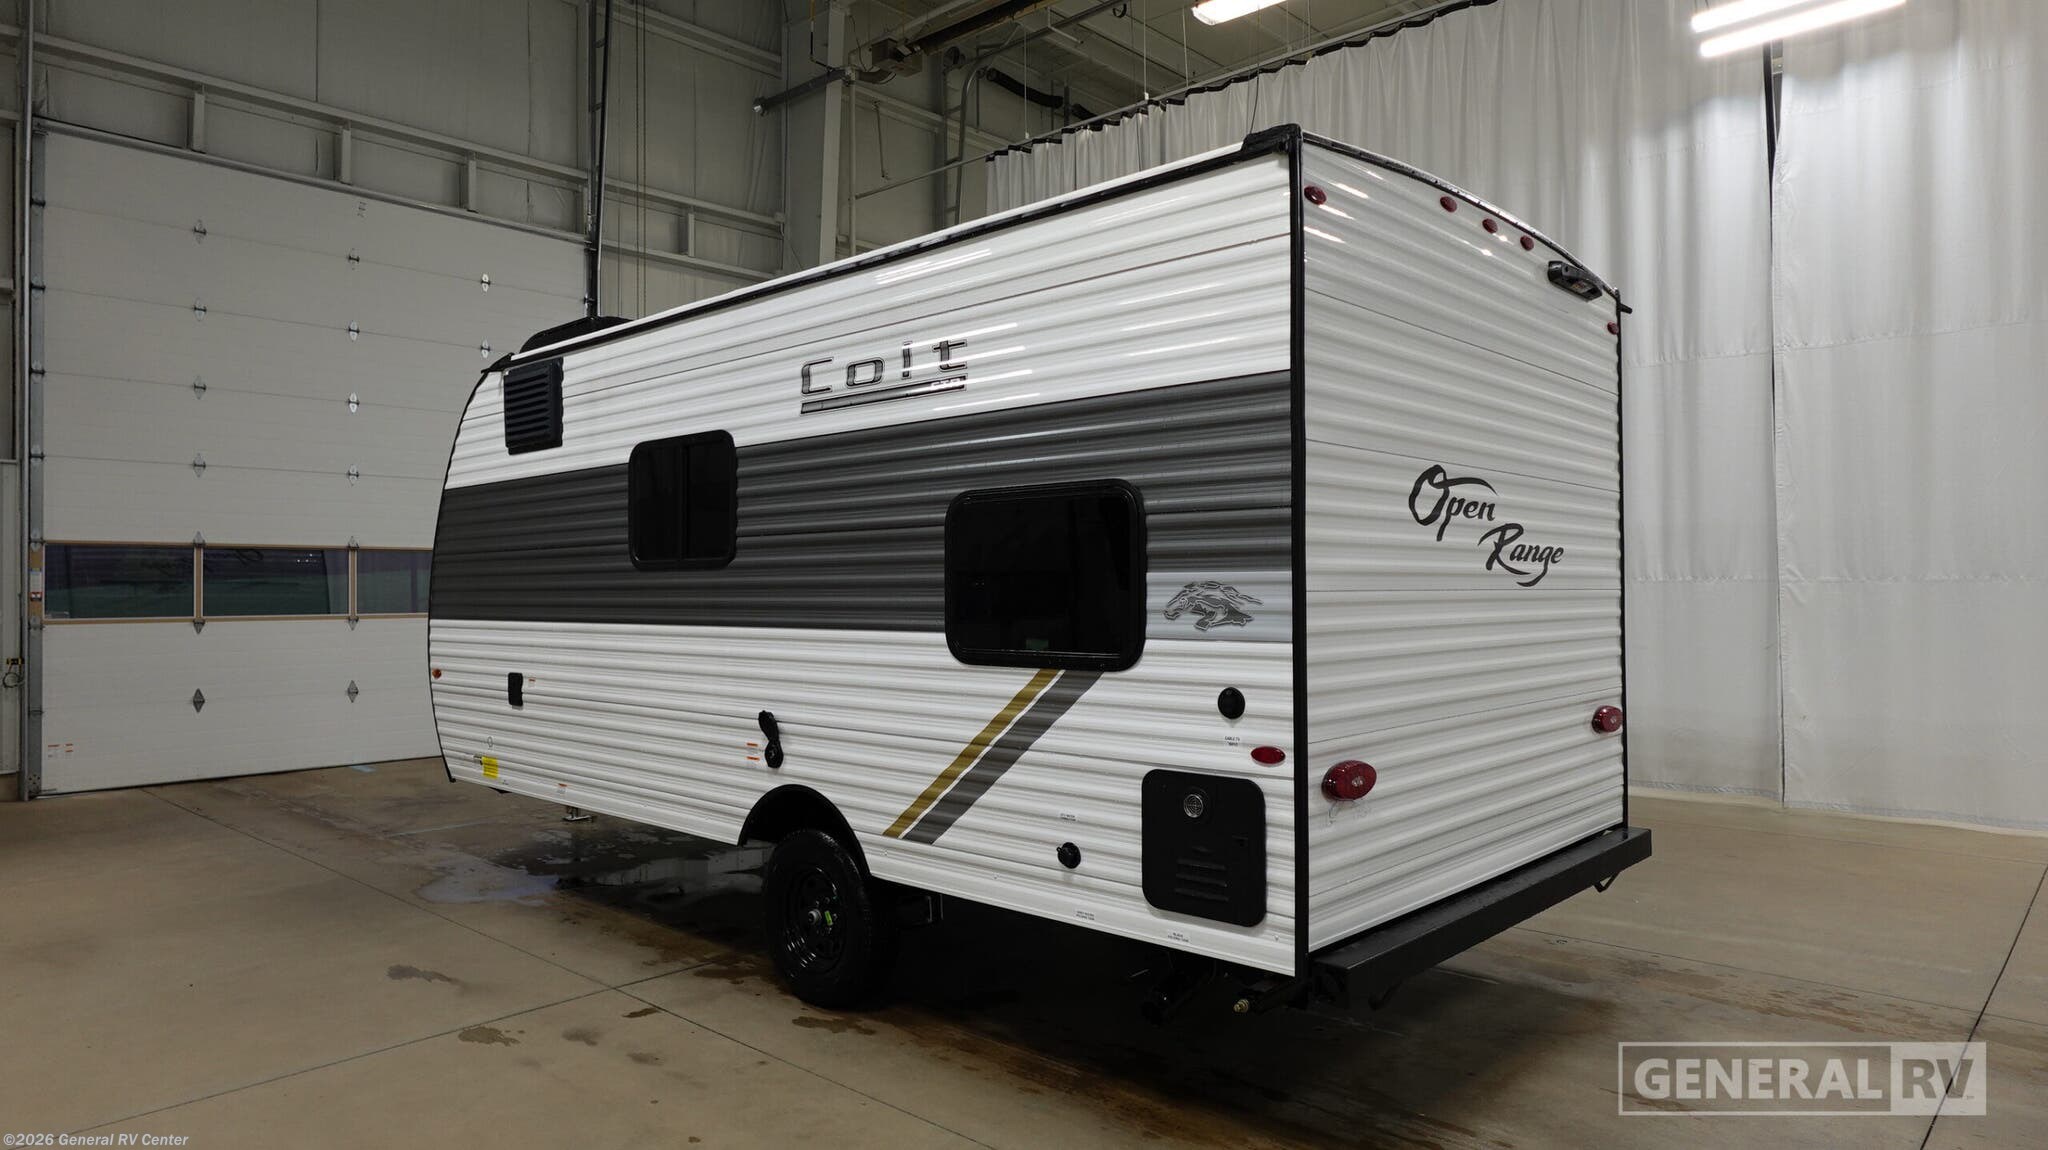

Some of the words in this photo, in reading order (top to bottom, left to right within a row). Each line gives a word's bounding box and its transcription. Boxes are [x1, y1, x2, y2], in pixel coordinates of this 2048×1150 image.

[801, 339, 968, 395] Colt
[1408, 464, 1498, 542] Open
[1477, 523, 1565, 588] Range
